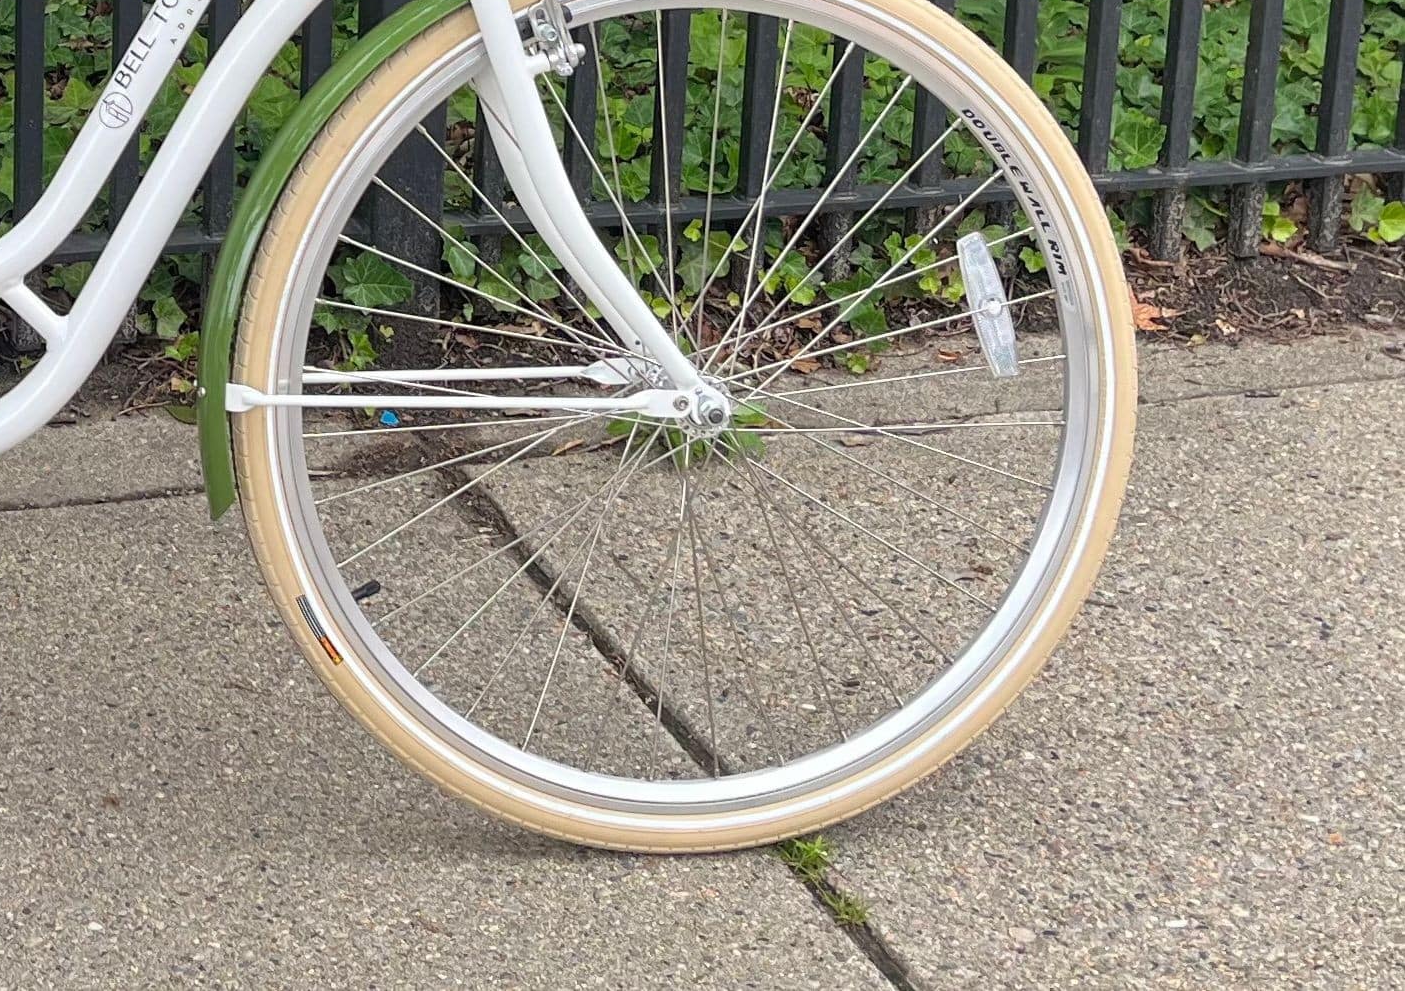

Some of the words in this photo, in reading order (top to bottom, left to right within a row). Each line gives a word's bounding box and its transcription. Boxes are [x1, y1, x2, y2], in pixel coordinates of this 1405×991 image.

[114, 36, 156, 90] BELL
[961, 109, 1024, 178] DOUBLE
[1019, 181, 1052, 233] WALL
[1047, 238, 1067, 276] RIM
